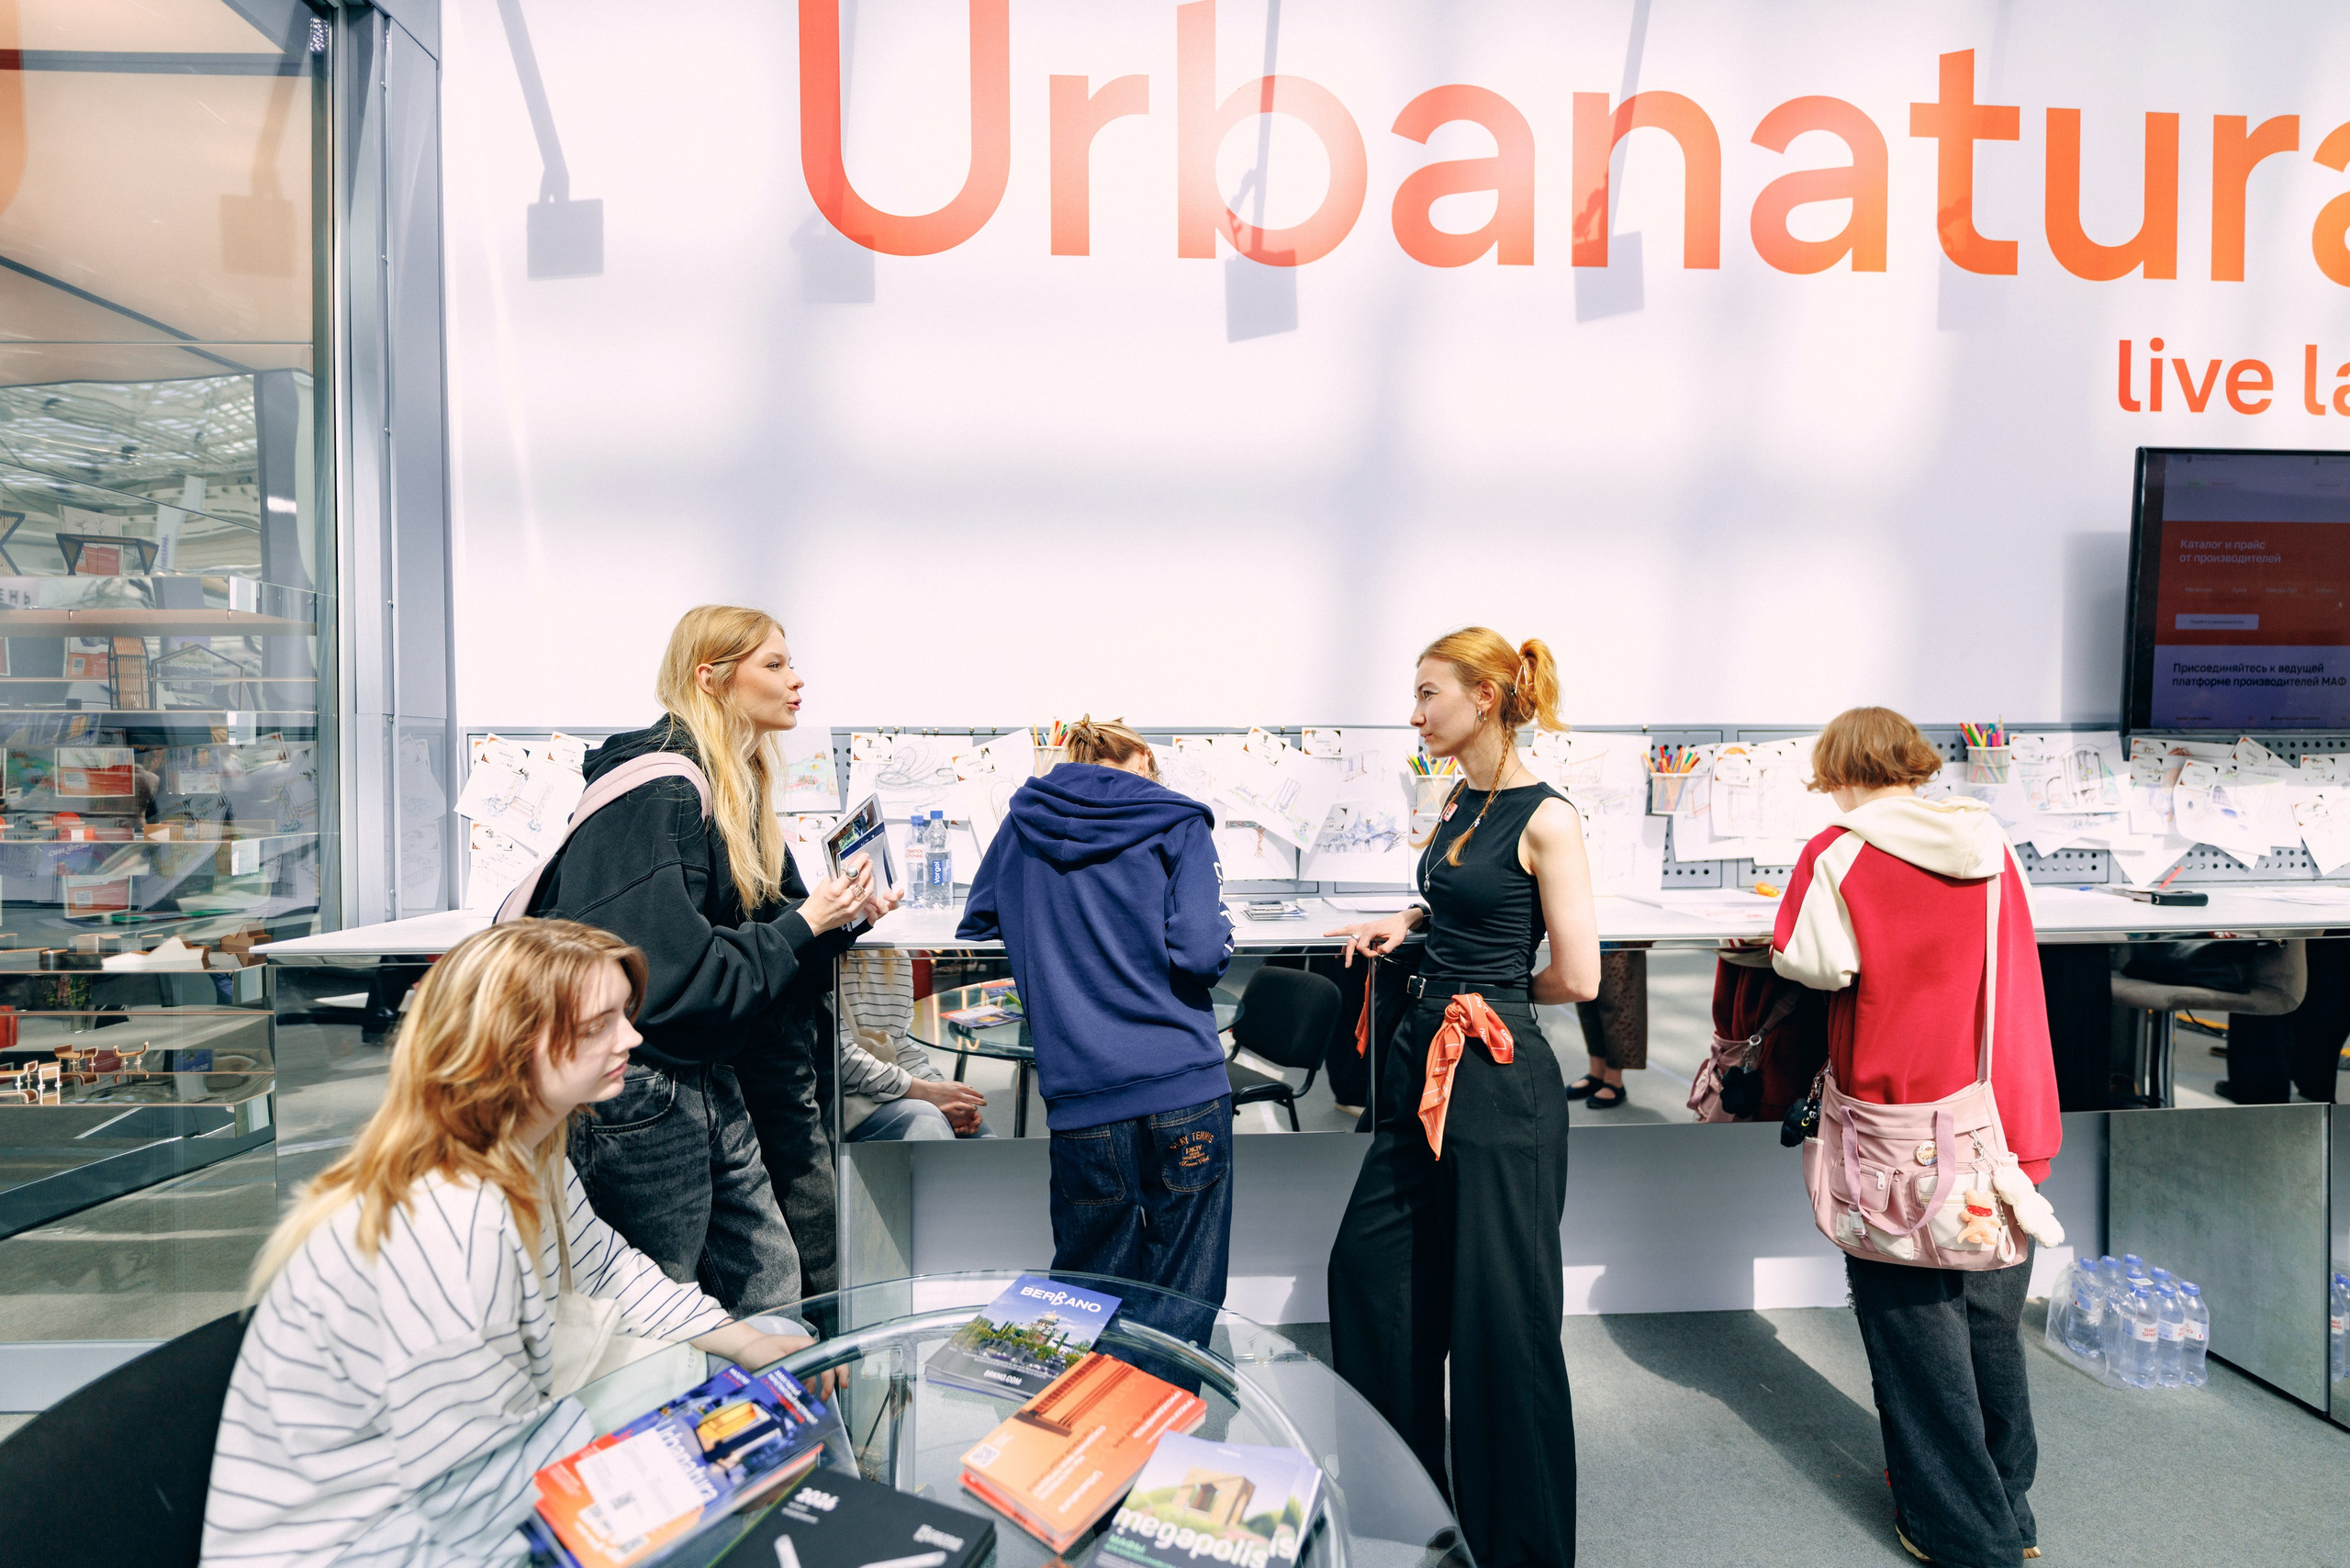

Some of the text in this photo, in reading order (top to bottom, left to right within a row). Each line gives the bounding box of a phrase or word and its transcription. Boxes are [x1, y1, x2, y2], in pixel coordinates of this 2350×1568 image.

[799, 0, 2350, 287] Urbanatur
[2118, 338, 2274, 415] live
[2180, 539, 2266, 551] Каталог и прайс
[2179, 553, 2281, 565] от производителей
[2173, 662, 2267, 675] Присоединяйтесь
[2278, 663, 2324, 676] ведущей
[2172, 676, 2347, 689] платформе производителей МАФ
[933, 861, 941, 884] Vorgol
[983, 1369, 1023, 1386] BRKNO.COM
[794, 1486, 841, 1513] 2026
[1112, 1506, 1270, 1568] megapolis
